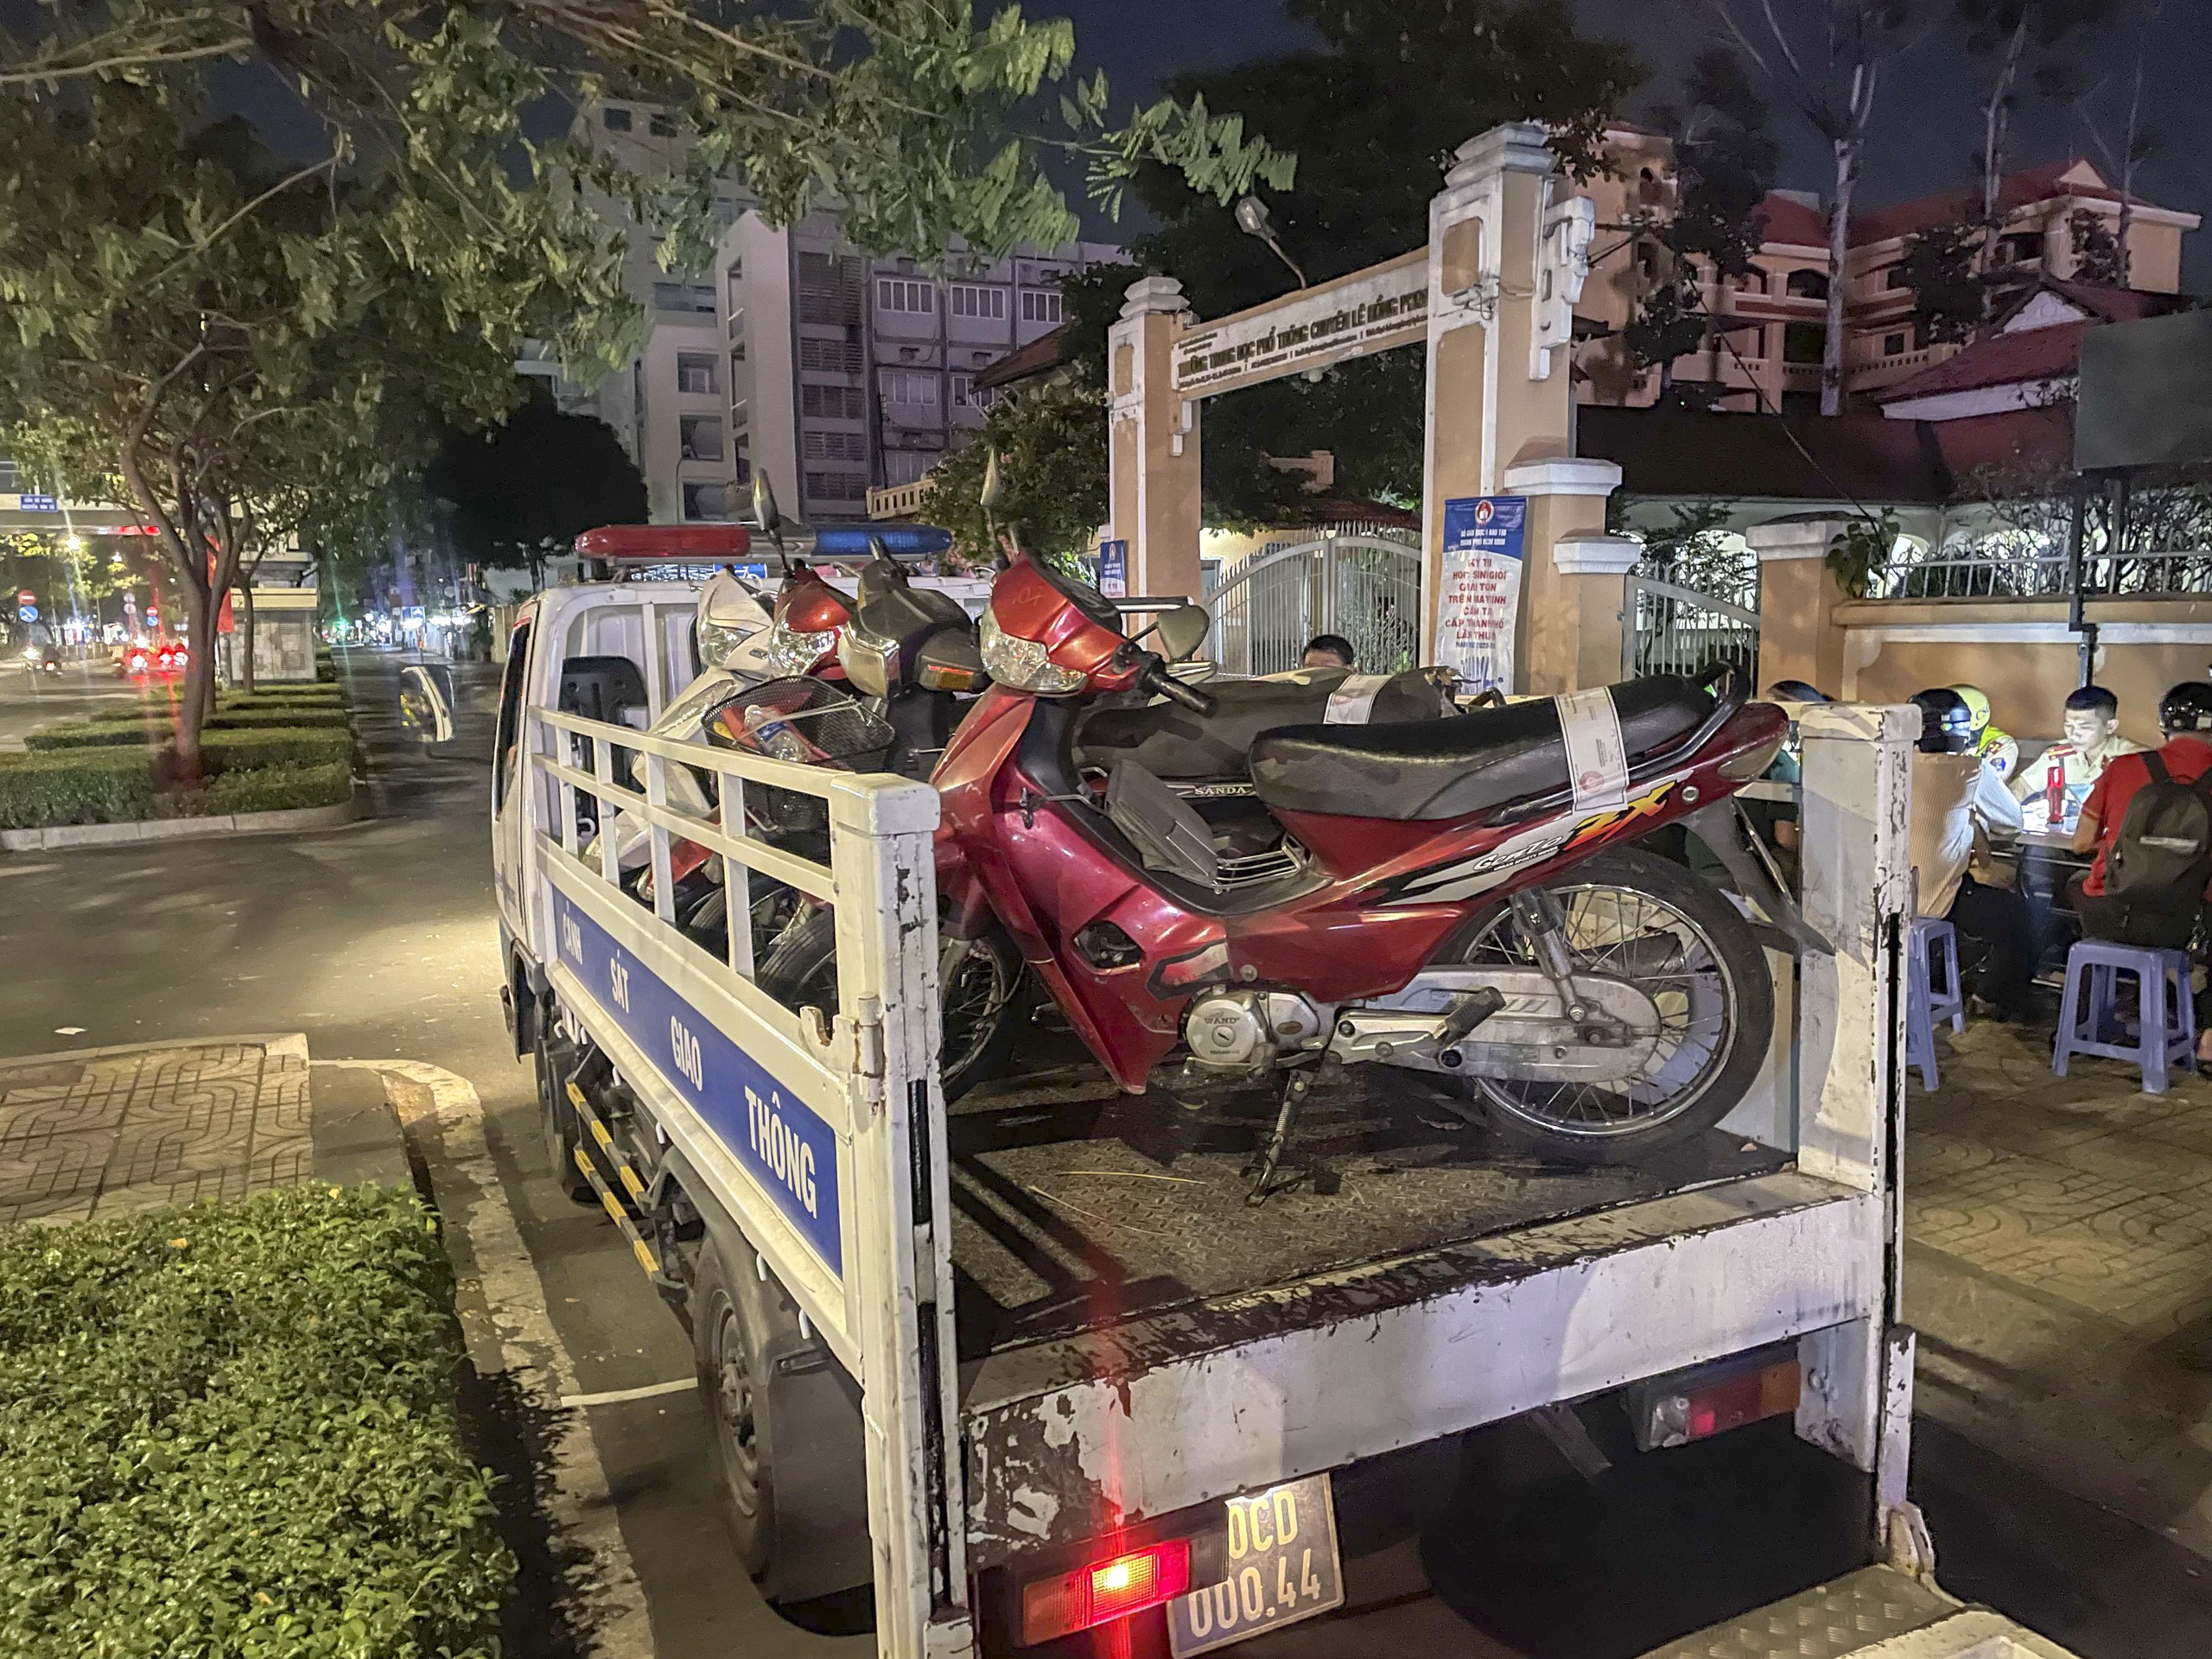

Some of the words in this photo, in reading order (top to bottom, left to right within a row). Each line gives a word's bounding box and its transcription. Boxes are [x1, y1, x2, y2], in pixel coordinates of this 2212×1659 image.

[1194, 786, 1248, 795] SANDA
[610, 949, 630, 1014] SÁT
[670, 1014, 703, 1092] GIAO
[744, 1085, 818, 1219] THÔNG
